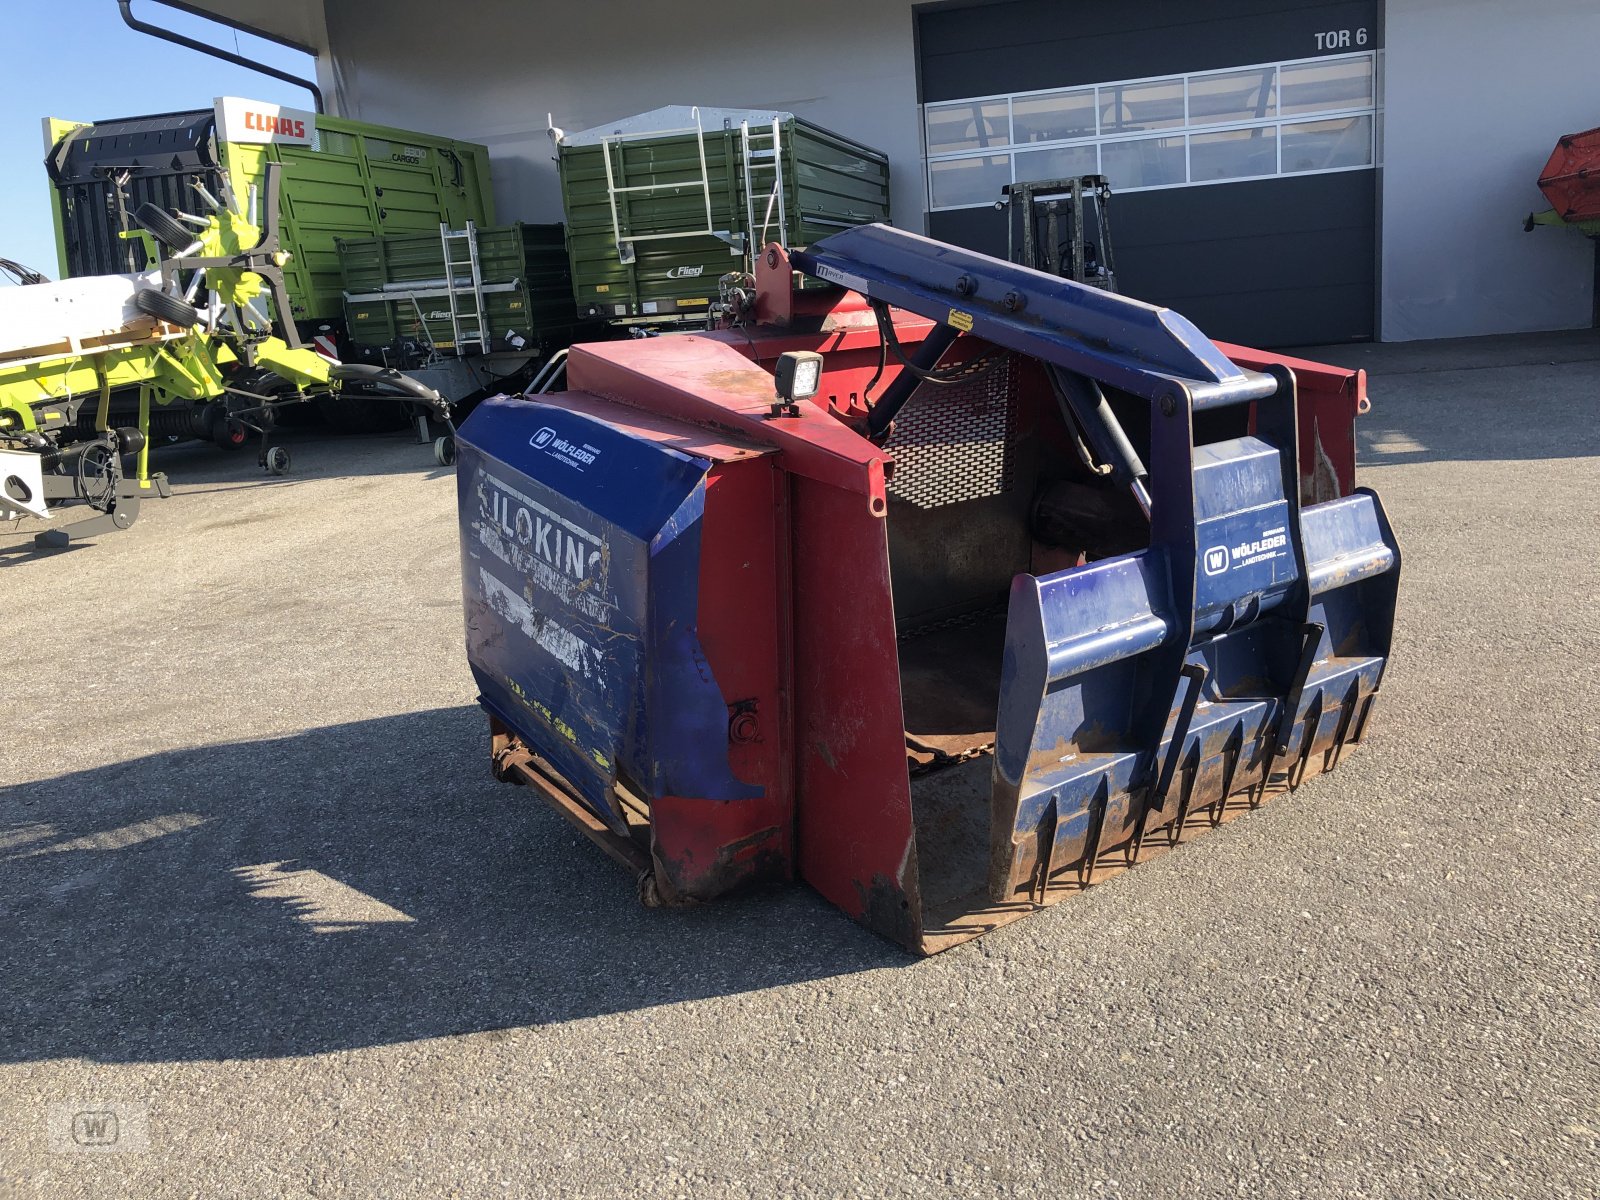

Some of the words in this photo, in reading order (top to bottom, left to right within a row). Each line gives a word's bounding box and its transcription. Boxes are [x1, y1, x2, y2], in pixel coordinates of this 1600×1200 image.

[1314, 29, 1351, 50] TOR
[1356, 27, 1368, 45] 6
[245, 111, 305, 138] CLAAS
[392, 153, 420, 165] CARGOS
[678, 265, 703, 276] Fliegl
[430, 310, 452, 321] Flieg
[535, 431, 551, 444] W
[552, 438, 596, 465] WÖLFLEDER
[551, 452, 579, 469] LANDTECHNIK
[1231, 534, 1286, 559] WÖLFLEDER
[1209, 552, 1223, 569] W
[1242, 551, 1277, 566] LANDTECHNIK
